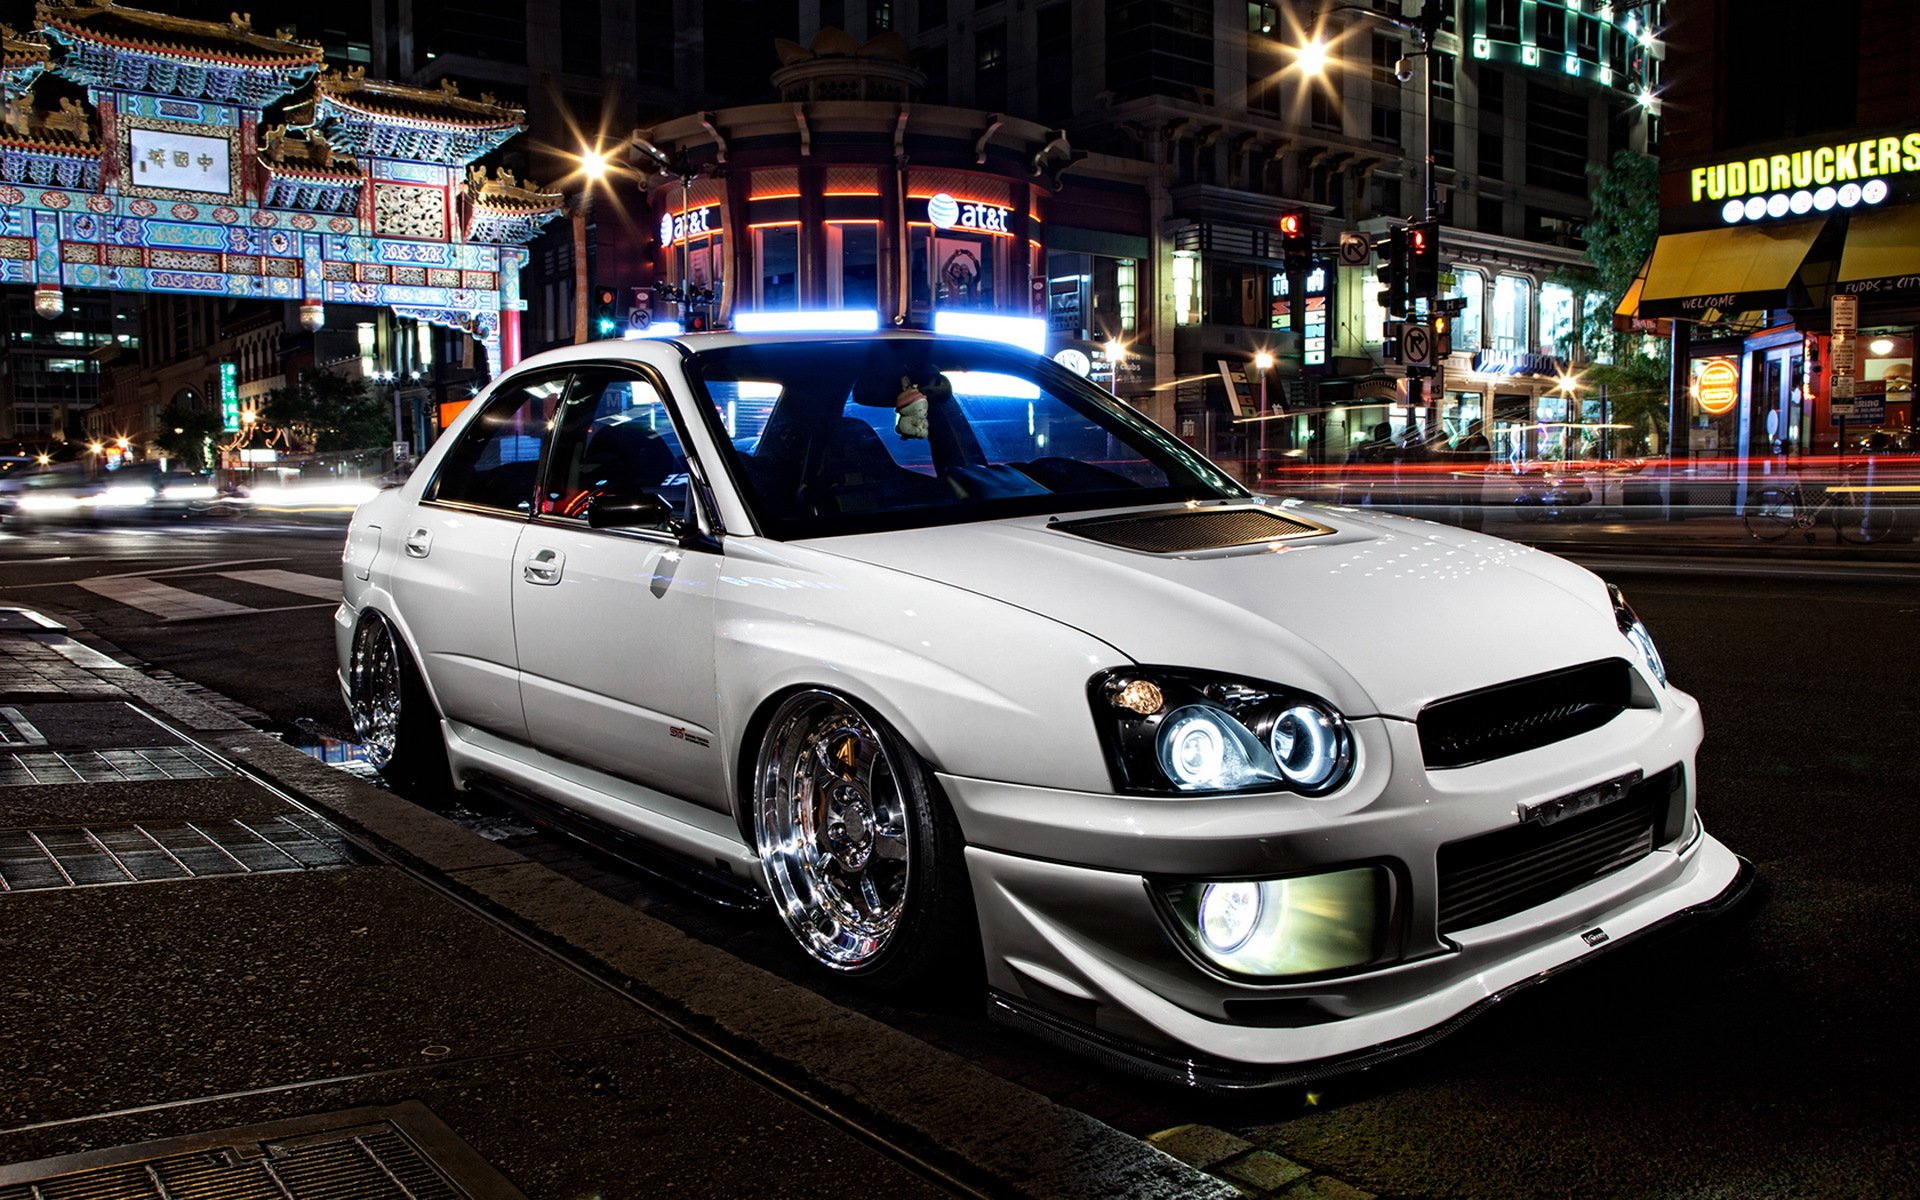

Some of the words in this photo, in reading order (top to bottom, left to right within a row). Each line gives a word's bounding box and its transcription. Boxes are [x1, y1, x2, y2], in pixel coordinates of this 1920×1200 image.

[1691, 132, 1920, 202] FUDDRUCKERS
[961, 203, 1008, 232] at&t
[1845, 279, 1882, 294] FUDDS
[1682, 294, 1736, 310] WELCOME
